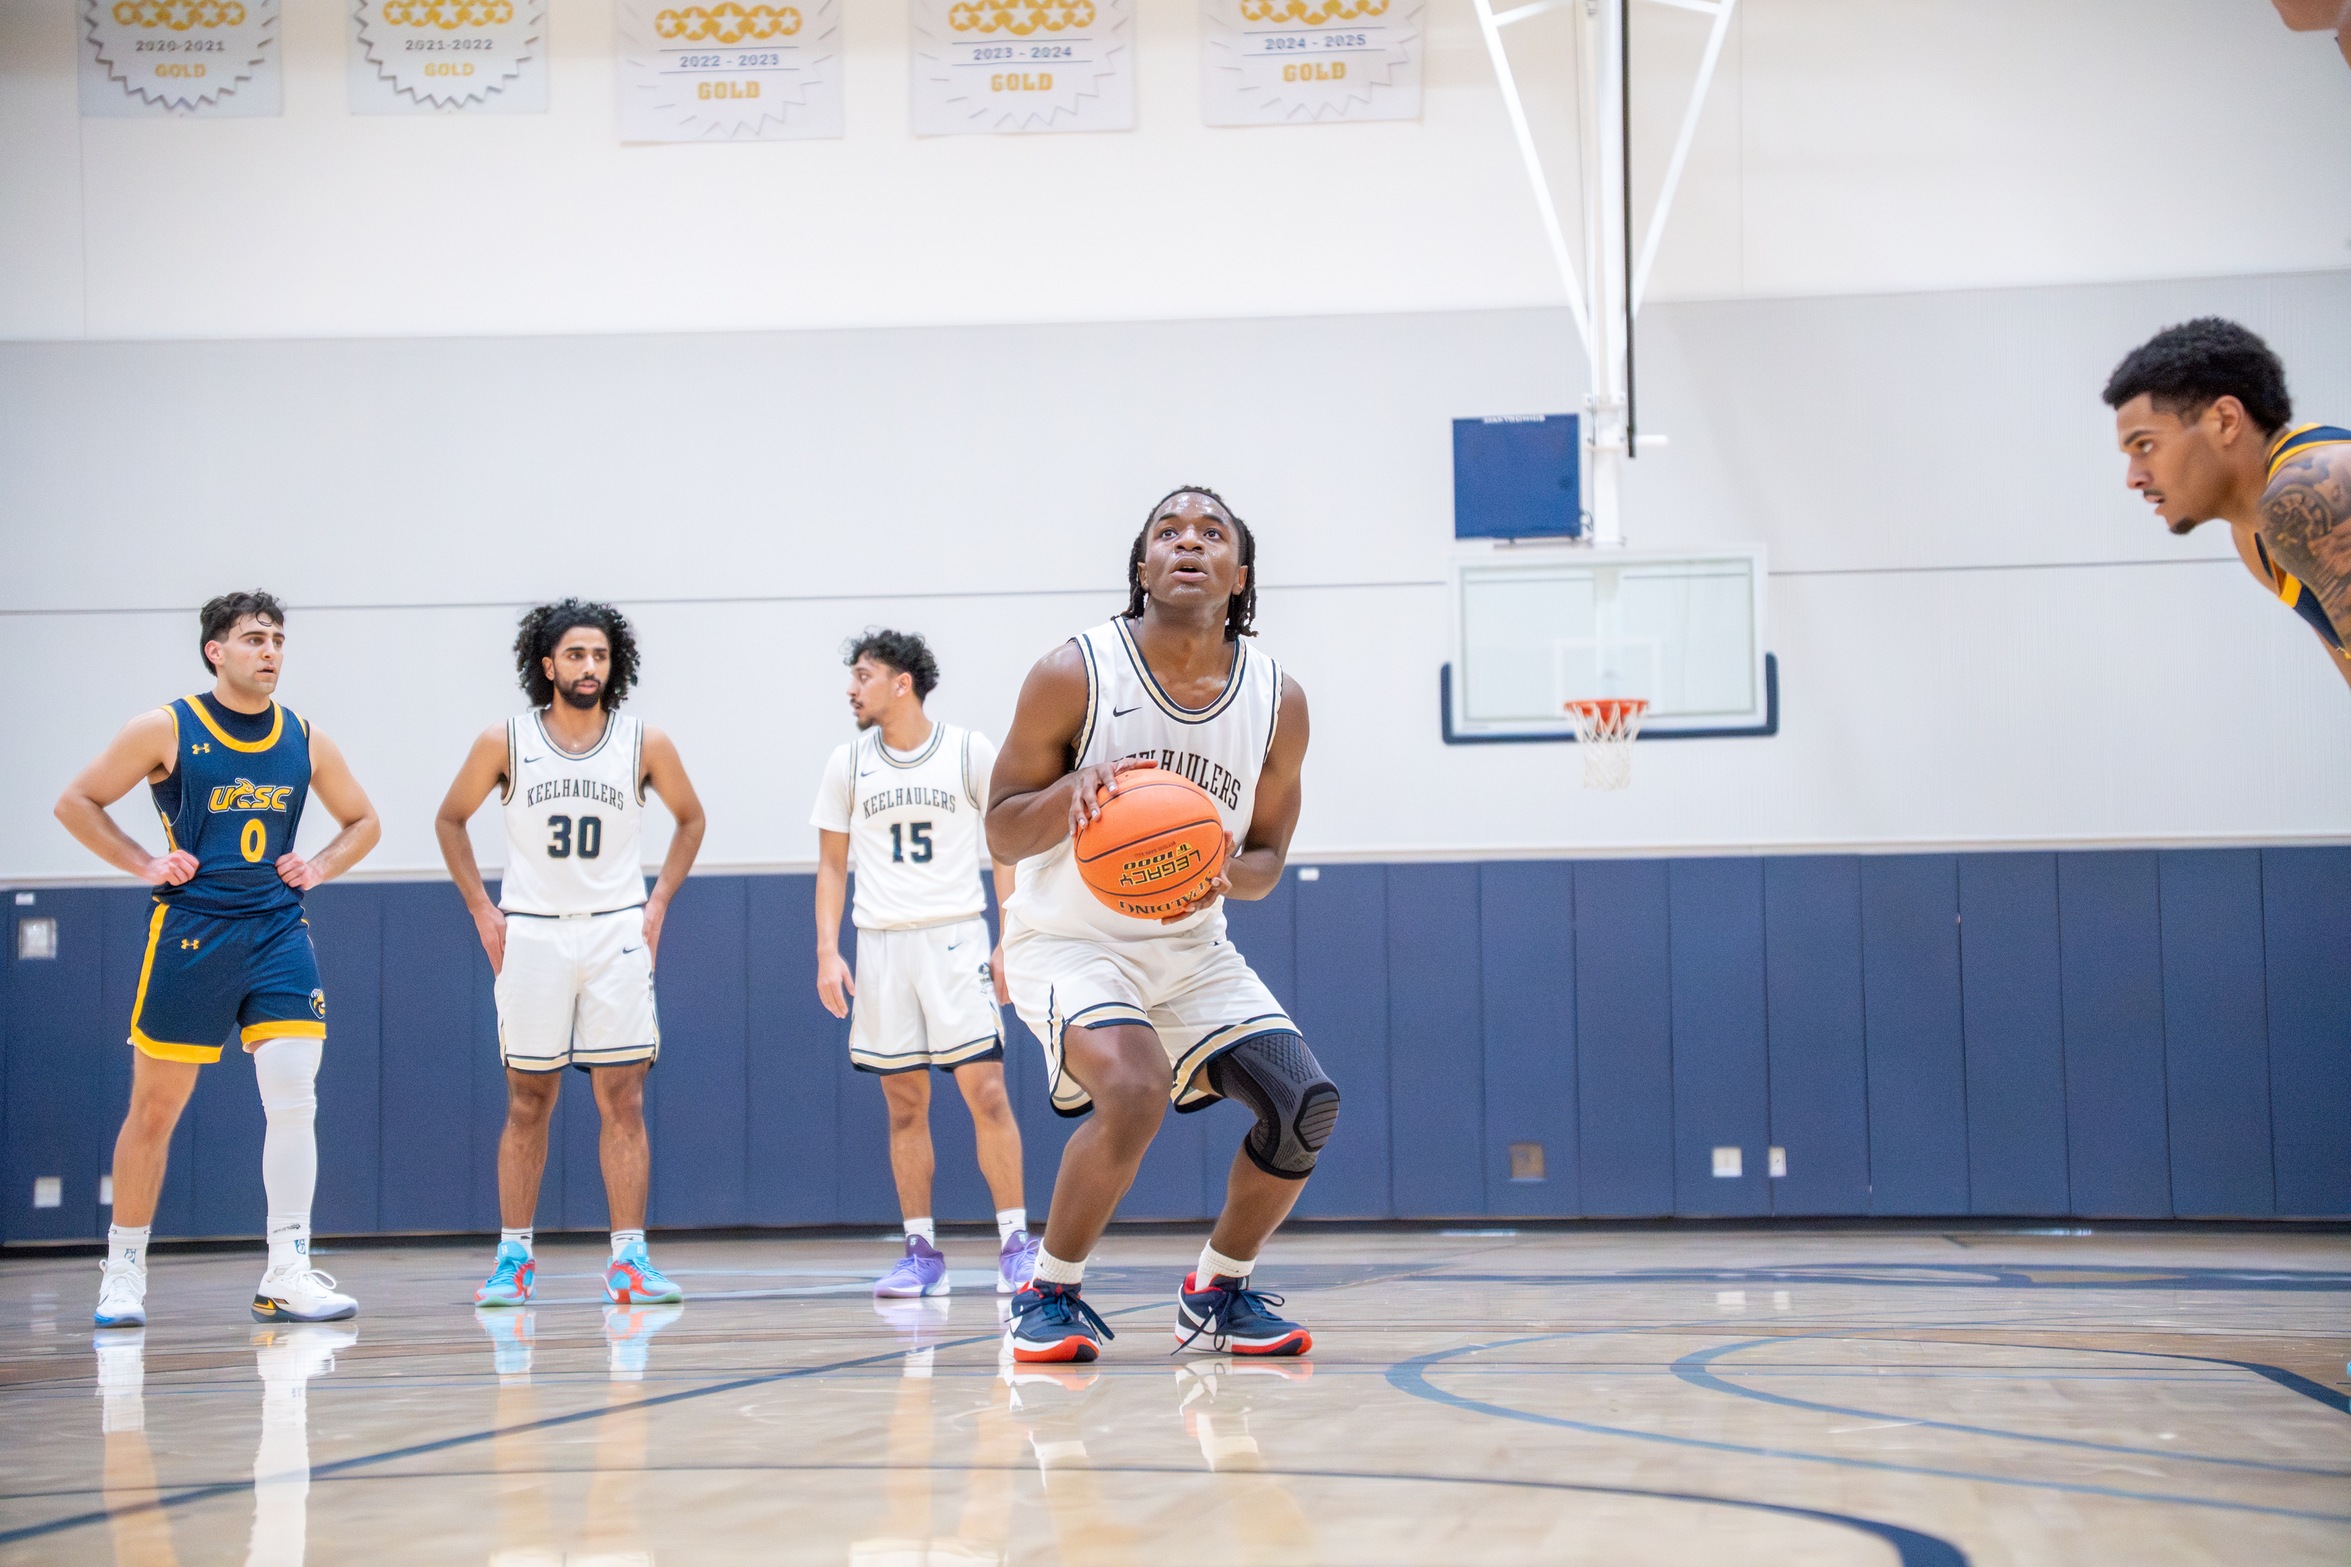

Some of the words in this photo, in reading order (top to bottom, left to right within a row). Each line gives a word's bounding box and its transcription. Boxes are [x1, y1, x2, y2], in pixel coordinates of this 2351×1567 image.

[136, 40, 224, 52] 2020-2021
[405, 39, 493, 50] 2021-2022
[1265, 37, 1306, 50] 2024
[1325, 34, 1366, 47] 2025
[680, 55, 721, 67] 2022
[738, 54, 779, 66] 2023
[972, 47, 1013, 60] 2023
[1030, 46, 1072, 58] 2024
[155, 63, 206, 78] GOLD
[424, 62, 475, 77] GOLD
[1282, 61, 1346, 82] GOLD
[697, 81, 760, 100] GOLD
[991, 73, 1053, 92] GOLD
[1112, 749, 1241, 811] HAULERS
[208, 778, 293, 813] UCSC
[527, 778, 624, 811] KEELHAULERS
[863, 787, 956, 819] KEELHAULERS
[240, 818, 266, 862] 0
[547, 815, 601, 859] 30
[890, 821, 933, 864] 15
[1119, 849, 1201, 887] LEGACY
[1123, 850, 1174, 871] 1000
